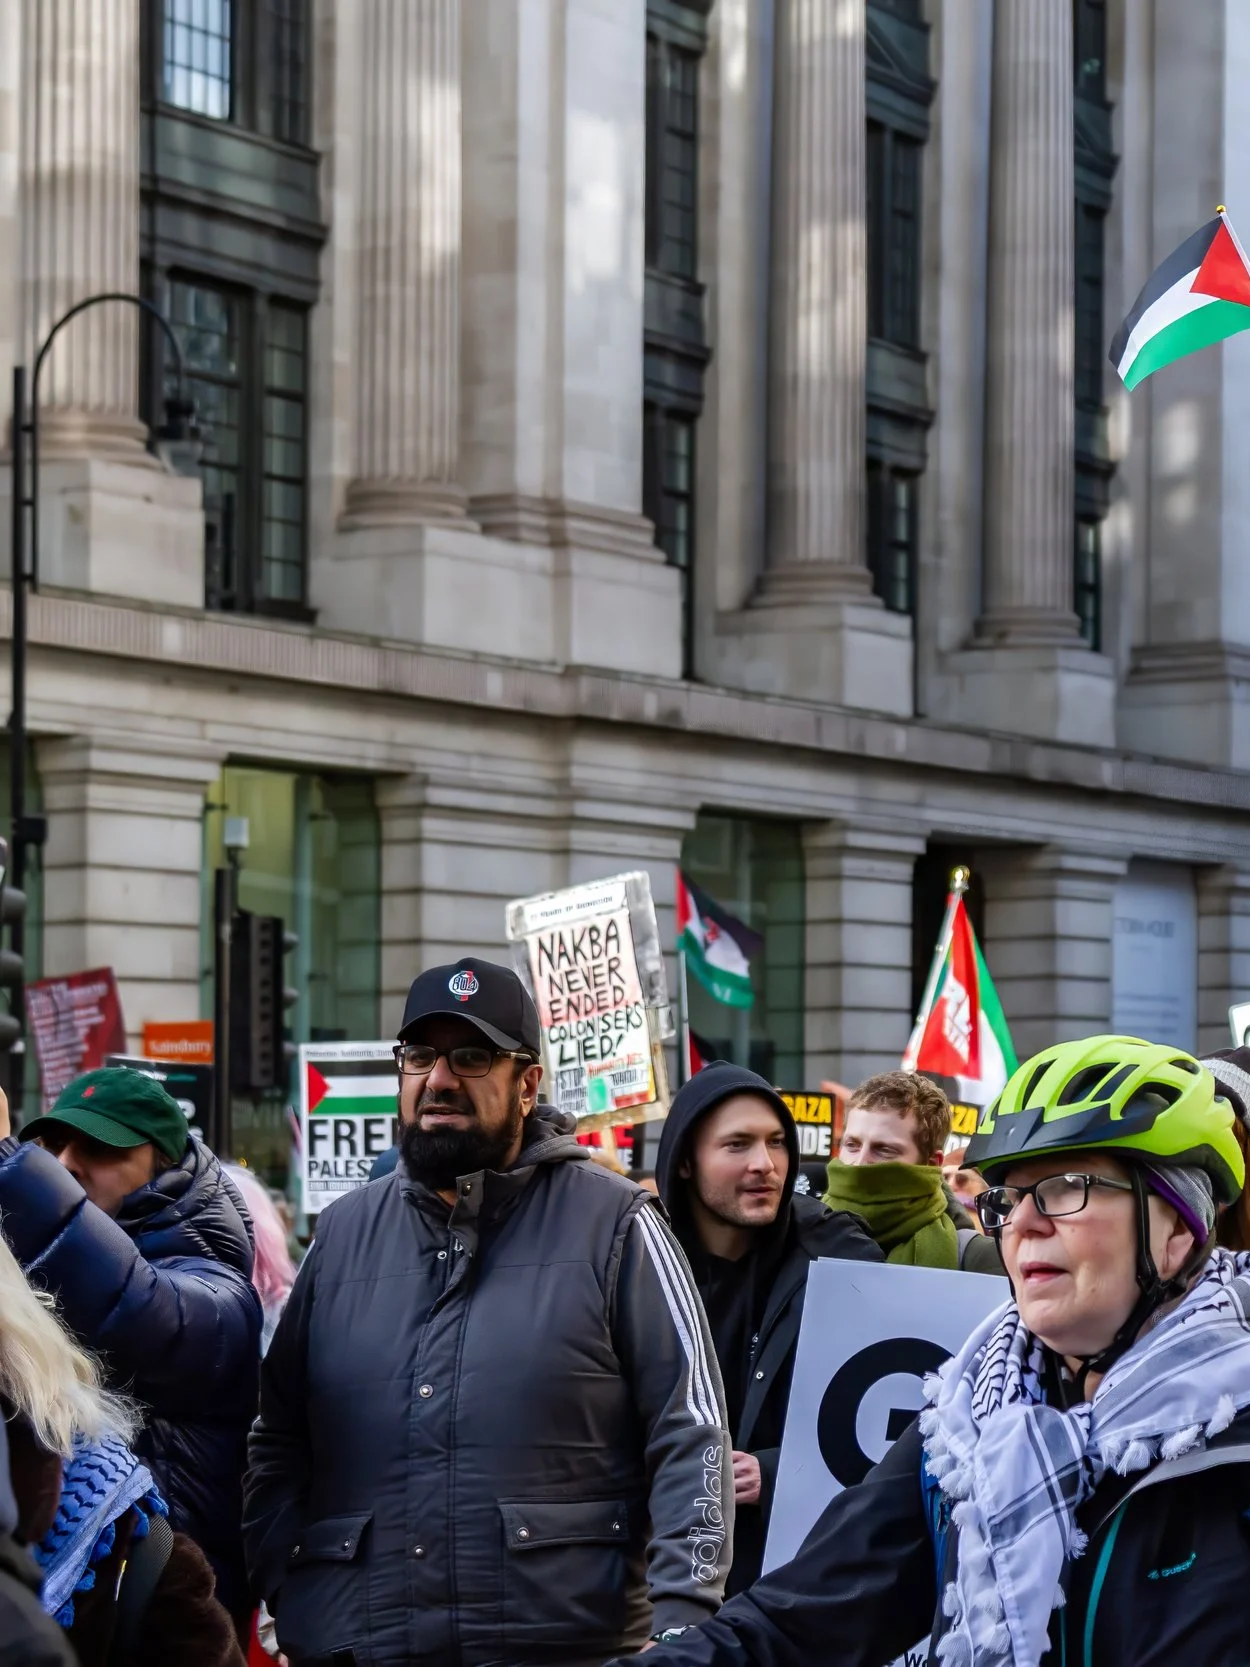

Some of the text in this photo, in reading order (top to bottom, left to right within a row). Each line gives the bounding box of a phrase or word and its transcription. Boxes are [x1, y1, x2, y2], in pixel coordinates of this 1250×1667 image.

[538, 918, 621, 978] NAKBA
[549, 957, 625, 998] NEVER
[550, 987, 626, 1024] ENDED
[558, 1034, 625, 1067] LIED!
[309, 1159, 373, 1179] PALES
[687, 1445, 726, 1585] adidas
